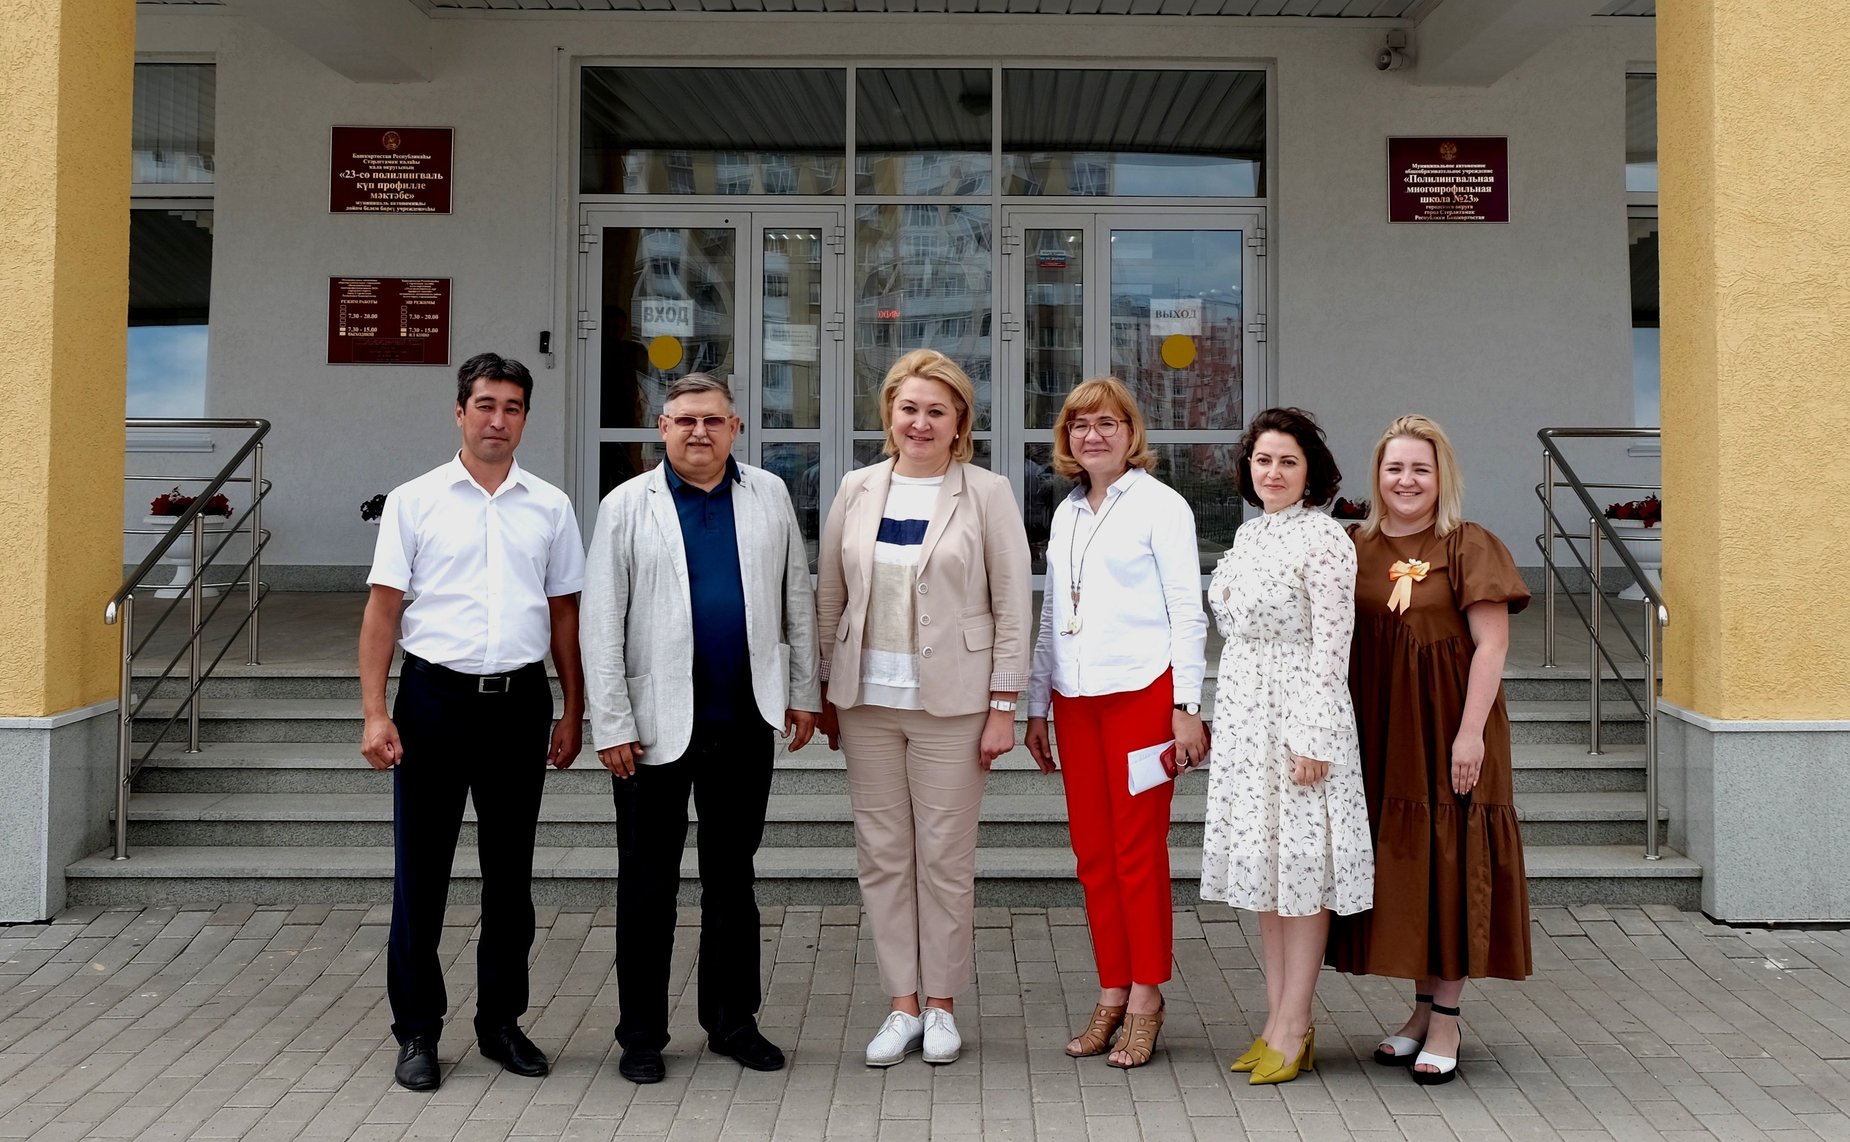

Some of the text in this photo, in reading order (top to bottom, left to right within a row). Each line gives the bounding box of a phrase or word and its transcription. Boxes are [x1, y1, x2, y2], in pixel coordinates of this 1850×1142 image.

[1404, 174, 1494, 183] «Полилингвальная
[378, 181, 426, 191] профилле
[1407, 184, 1492, 195] многопрофильная
[370, 190, 415, 200] мәктәбе»
[1452, 194, 1479, 203] №23»
[643, 306, 688, 326] ВХОД
[1156, 310, 1196, 319] ВЫХОД
